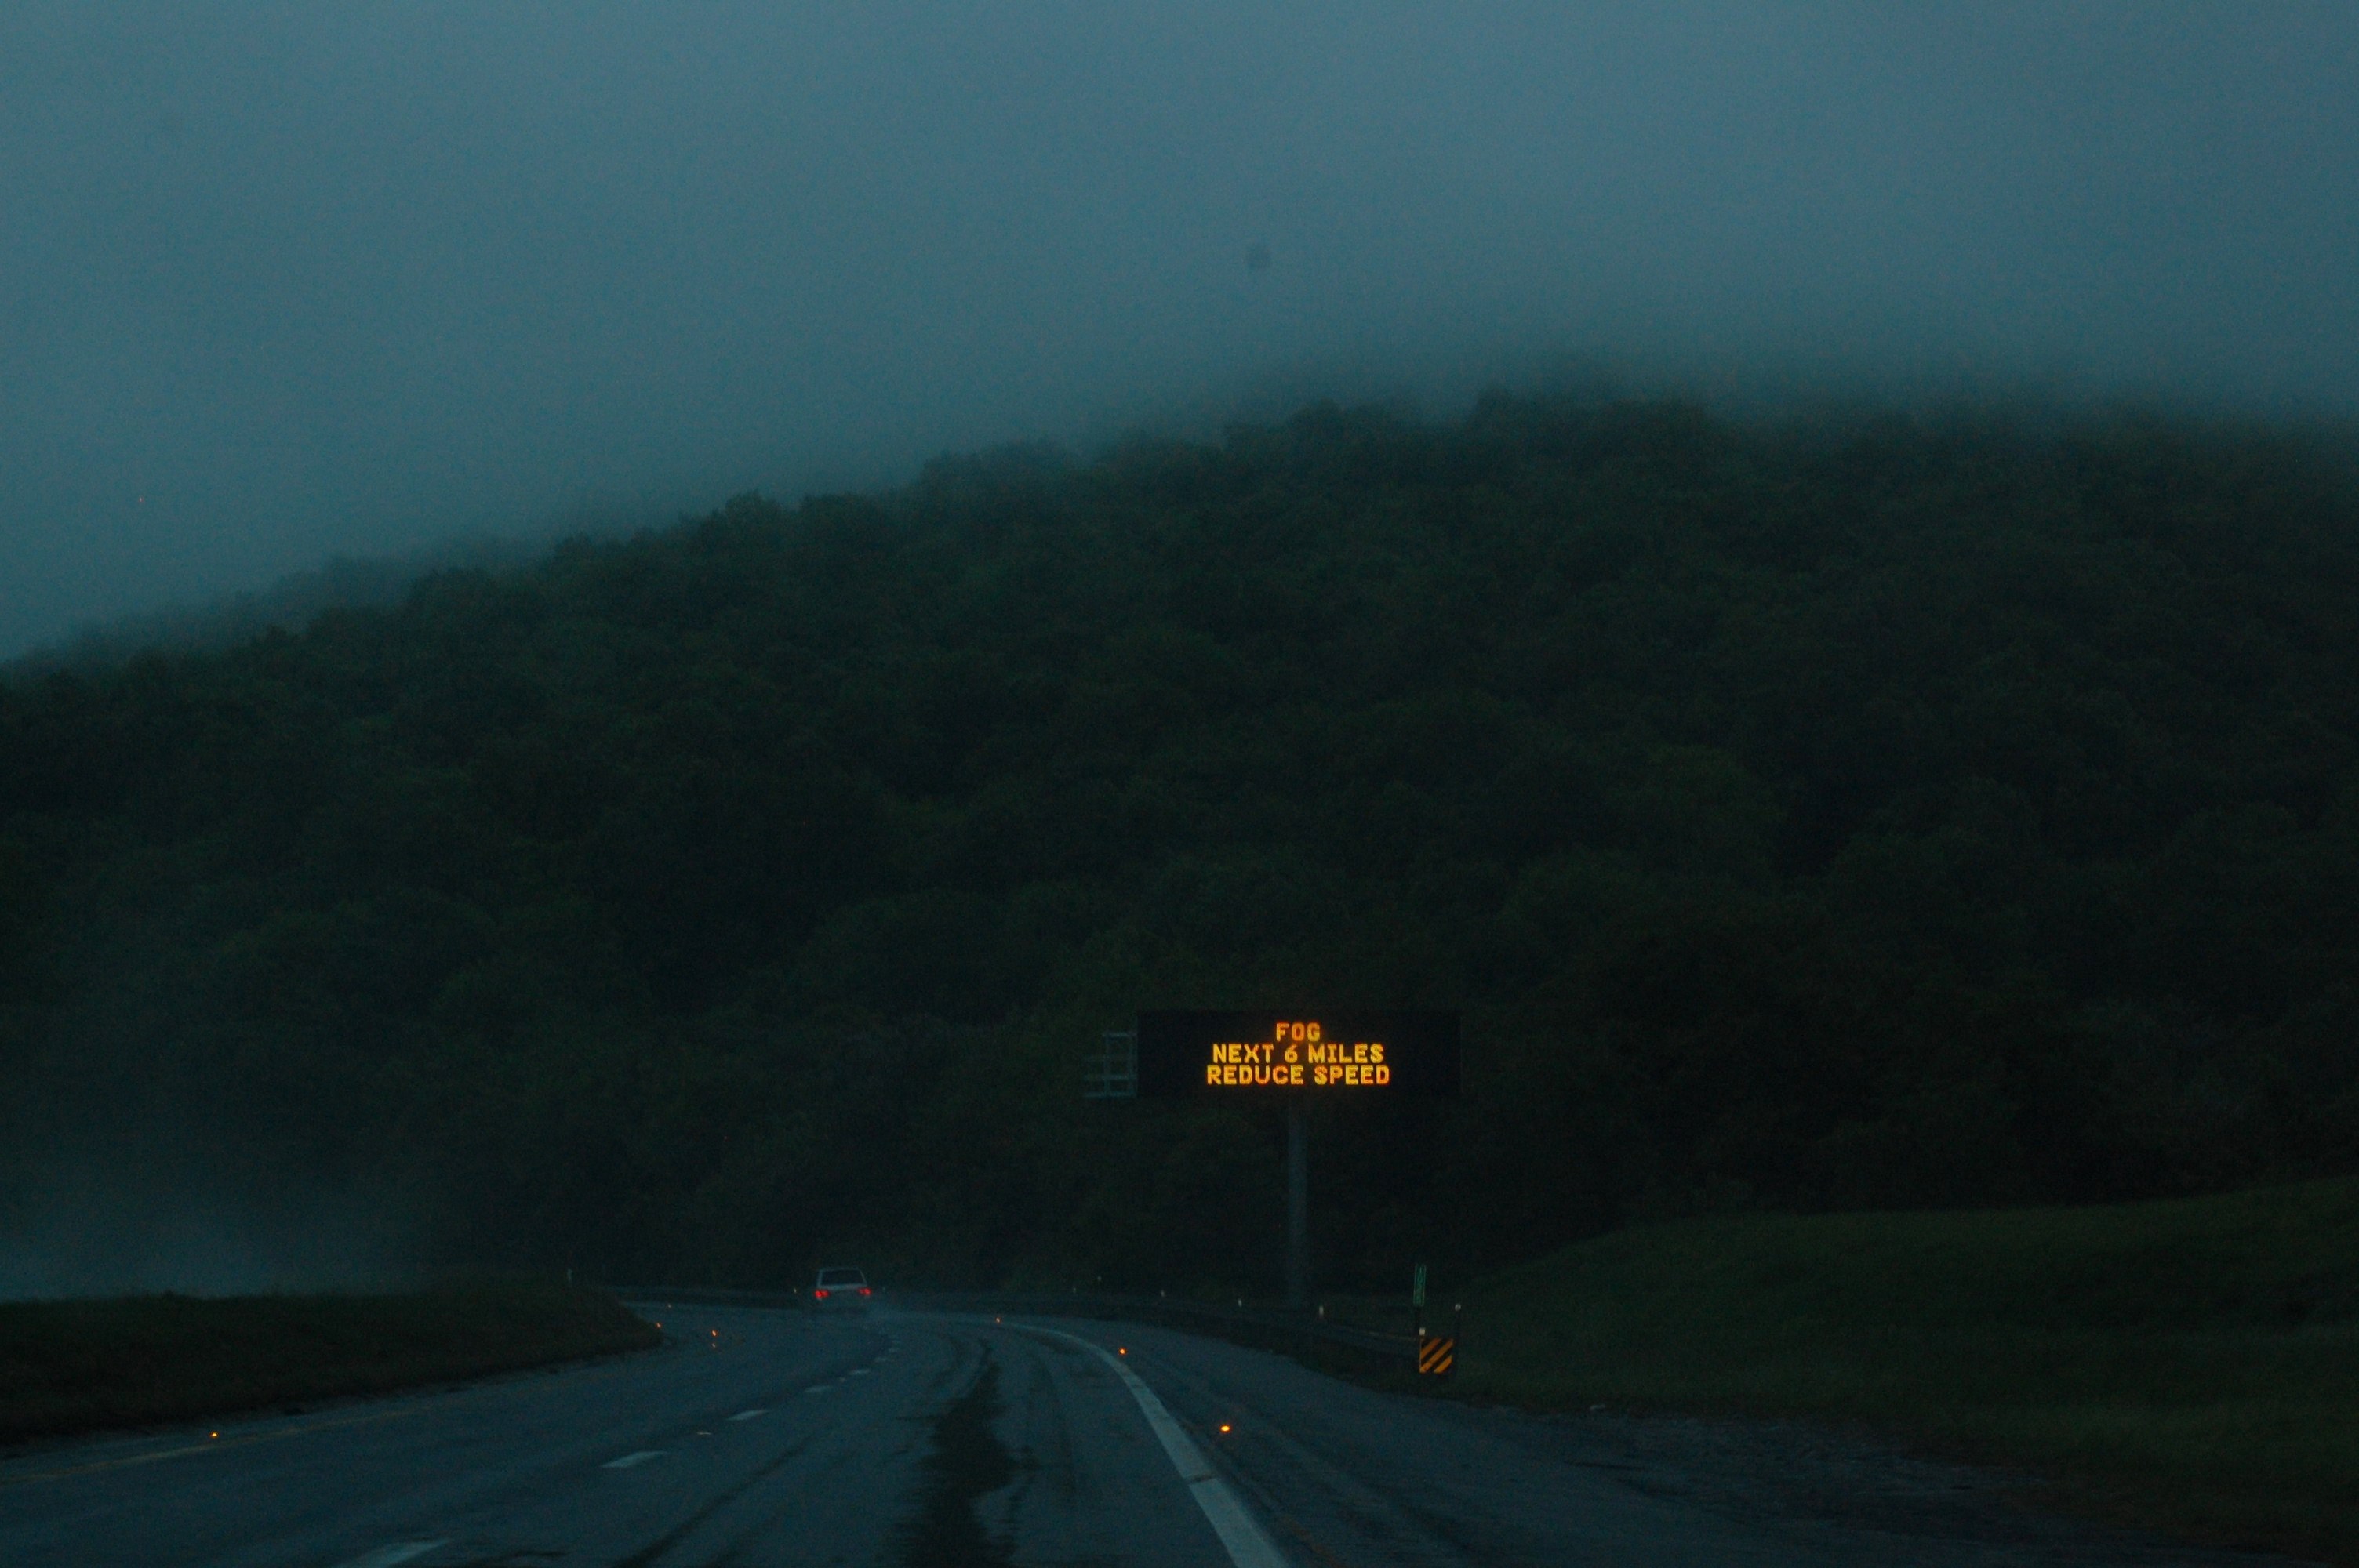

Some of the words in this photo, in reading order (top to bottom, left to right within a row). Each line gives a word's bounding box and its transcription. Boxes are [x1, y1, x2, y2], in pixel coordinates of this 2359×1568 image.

[1276, 1022, 1321, 1042] FOG
[1212, 1043, 1274, 1063] NEXT
[1284, 1043, 1298, 1063] 6
[1307, 1043, 1383, 1064] MILES
[1206, 1064, 1304, 1084] REDUCE
[1313, 1064, 1390, 1085] SPEED
